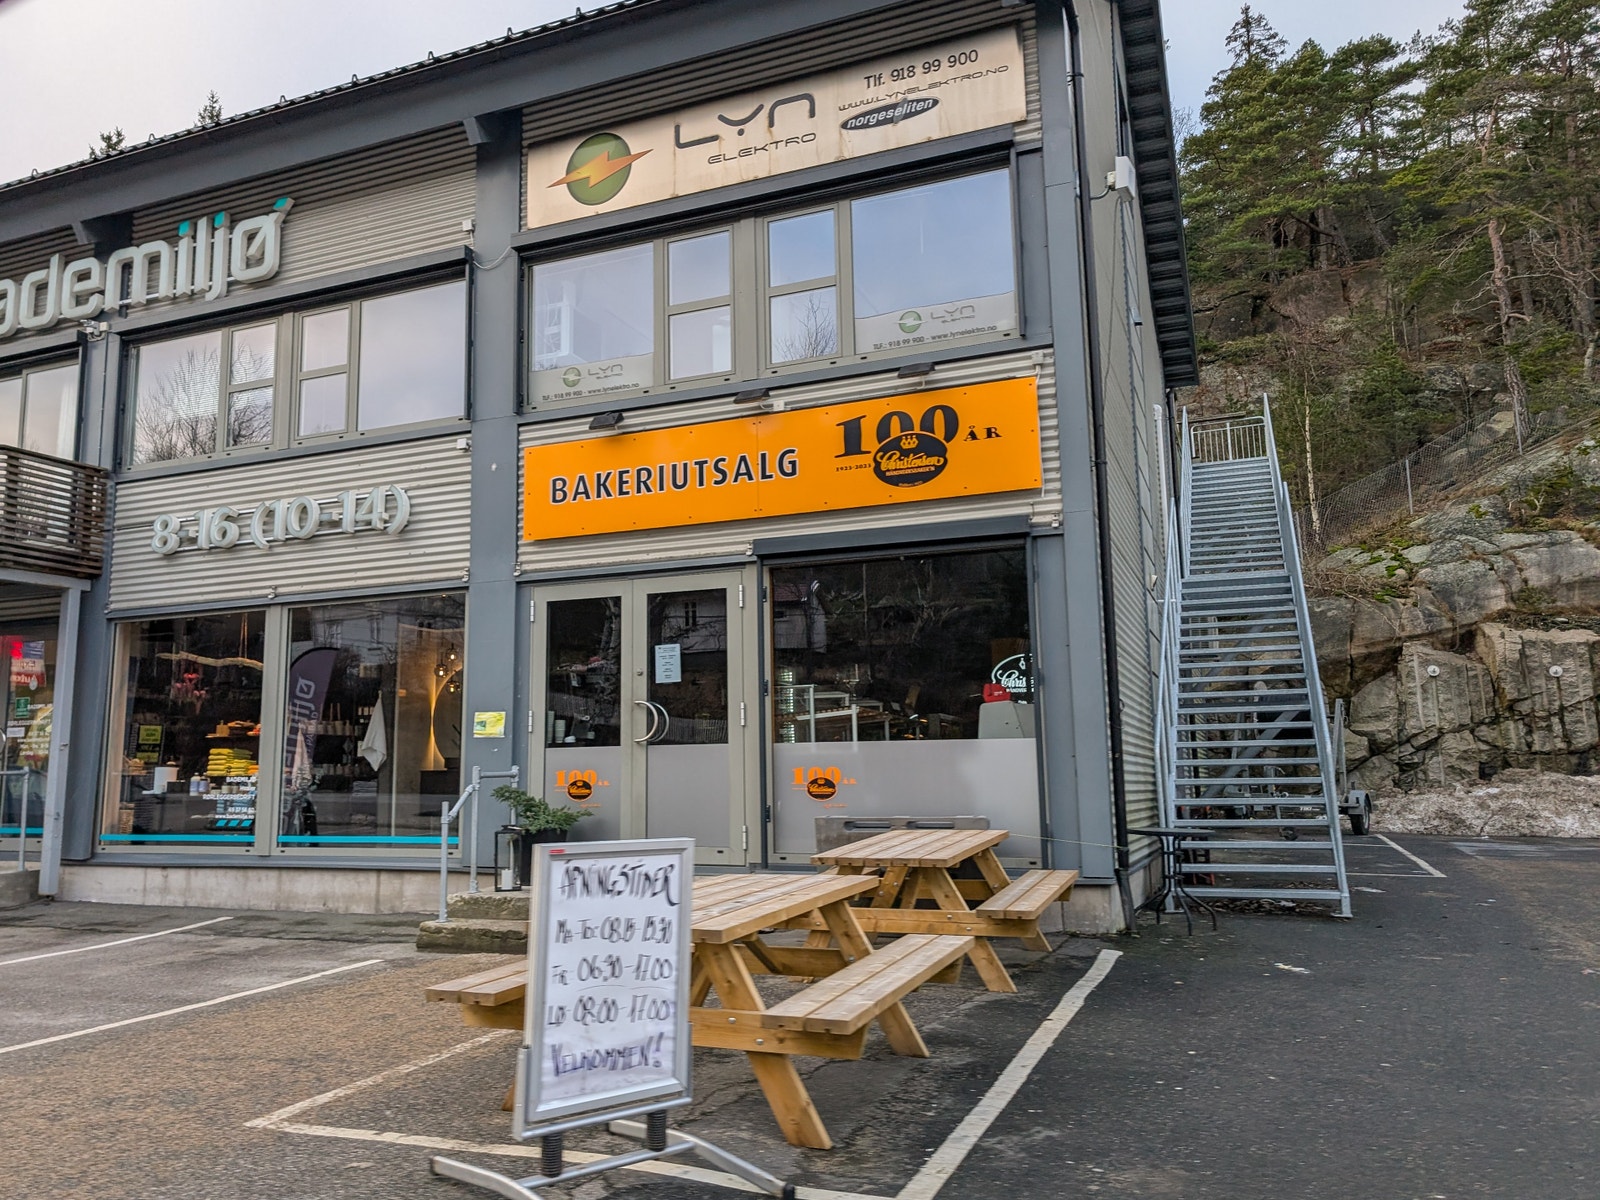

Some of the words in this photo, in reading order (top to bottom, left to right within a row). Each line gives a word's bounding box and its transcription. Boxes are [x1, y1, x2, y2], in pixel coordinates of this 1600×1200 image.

[864, 73, 886, 89] Tlf.
[890, 65, 916, 82] 918
[922, 59, 941, 75] 99
[947, 49, 979, 68] 900
[846, 99, 934, 128] norgeseliten
[707, 132, 817, 165] ELEKTRO
[834, 404, 959, 458] 100
[550, 448, 799, 505] BAKERIUTSALG
[151, 505, 241, 556] 8-16
[250, 484, 411, 550] (10-14)
